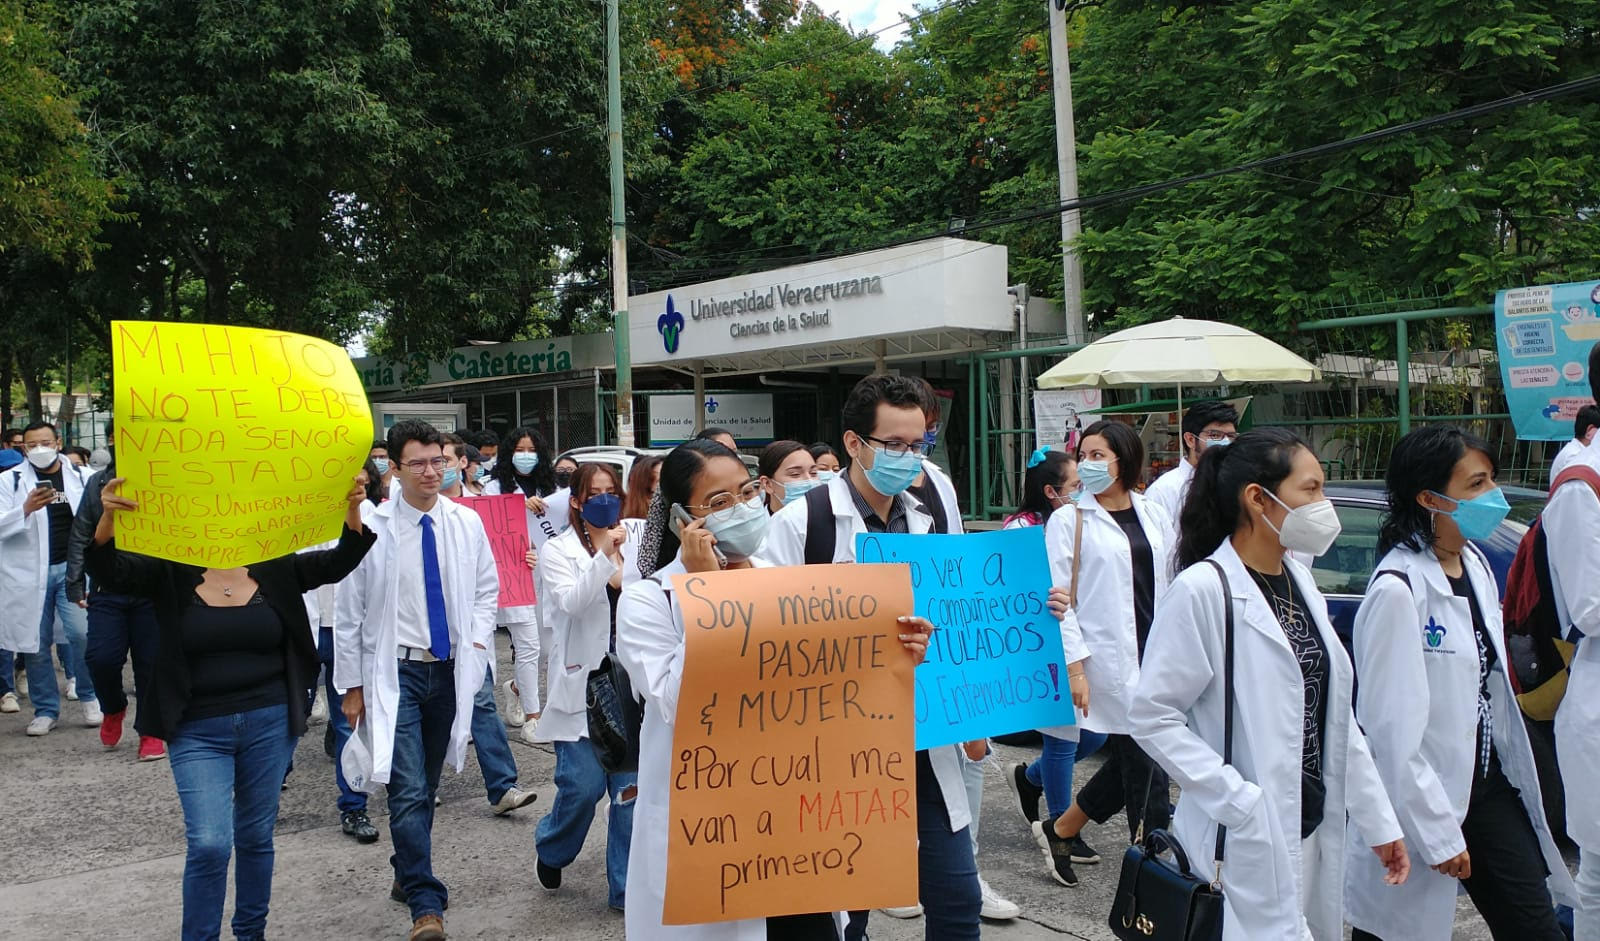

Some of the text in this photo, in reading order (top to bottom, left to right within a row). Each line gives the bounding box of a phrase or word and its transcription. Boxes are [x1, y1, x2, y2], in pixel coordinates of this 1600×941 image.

[690, 275, 884, 321] Universidad Veracruzana
[730, 309, 830, 339] Ciencias de la Salud
[119, 324, 185, 375] MI
[448, 343, 572, 381] Cafetería
[130, 386, 366, 422] NO TE DEBE
[740, 417, 748, 425] la
[750, 417, 771, 425] Salud
[119, 427, 225, 456] NADA
[119, 513, 197, 540] UTILES
[256, 538, 281, 559] YO
[931, 555, 964, 588] ver
[982, 552, 1006, 587] a
[685, 577, 878, 657] Soy médico
[927, 591, 1043, 640] compañeros
[759, 634, 887, 681] PASANTE
[922, 622, 1044, 665] TULADOS
[738, 679, 895, 732] MUJER...
[936, 662, 1060, 725] Enterrados!
[675, 736, 905, 790] ¿Por cual me
[680, 788, 911, 846] van a MATAR
[719, 832, 862, 914] primero?
